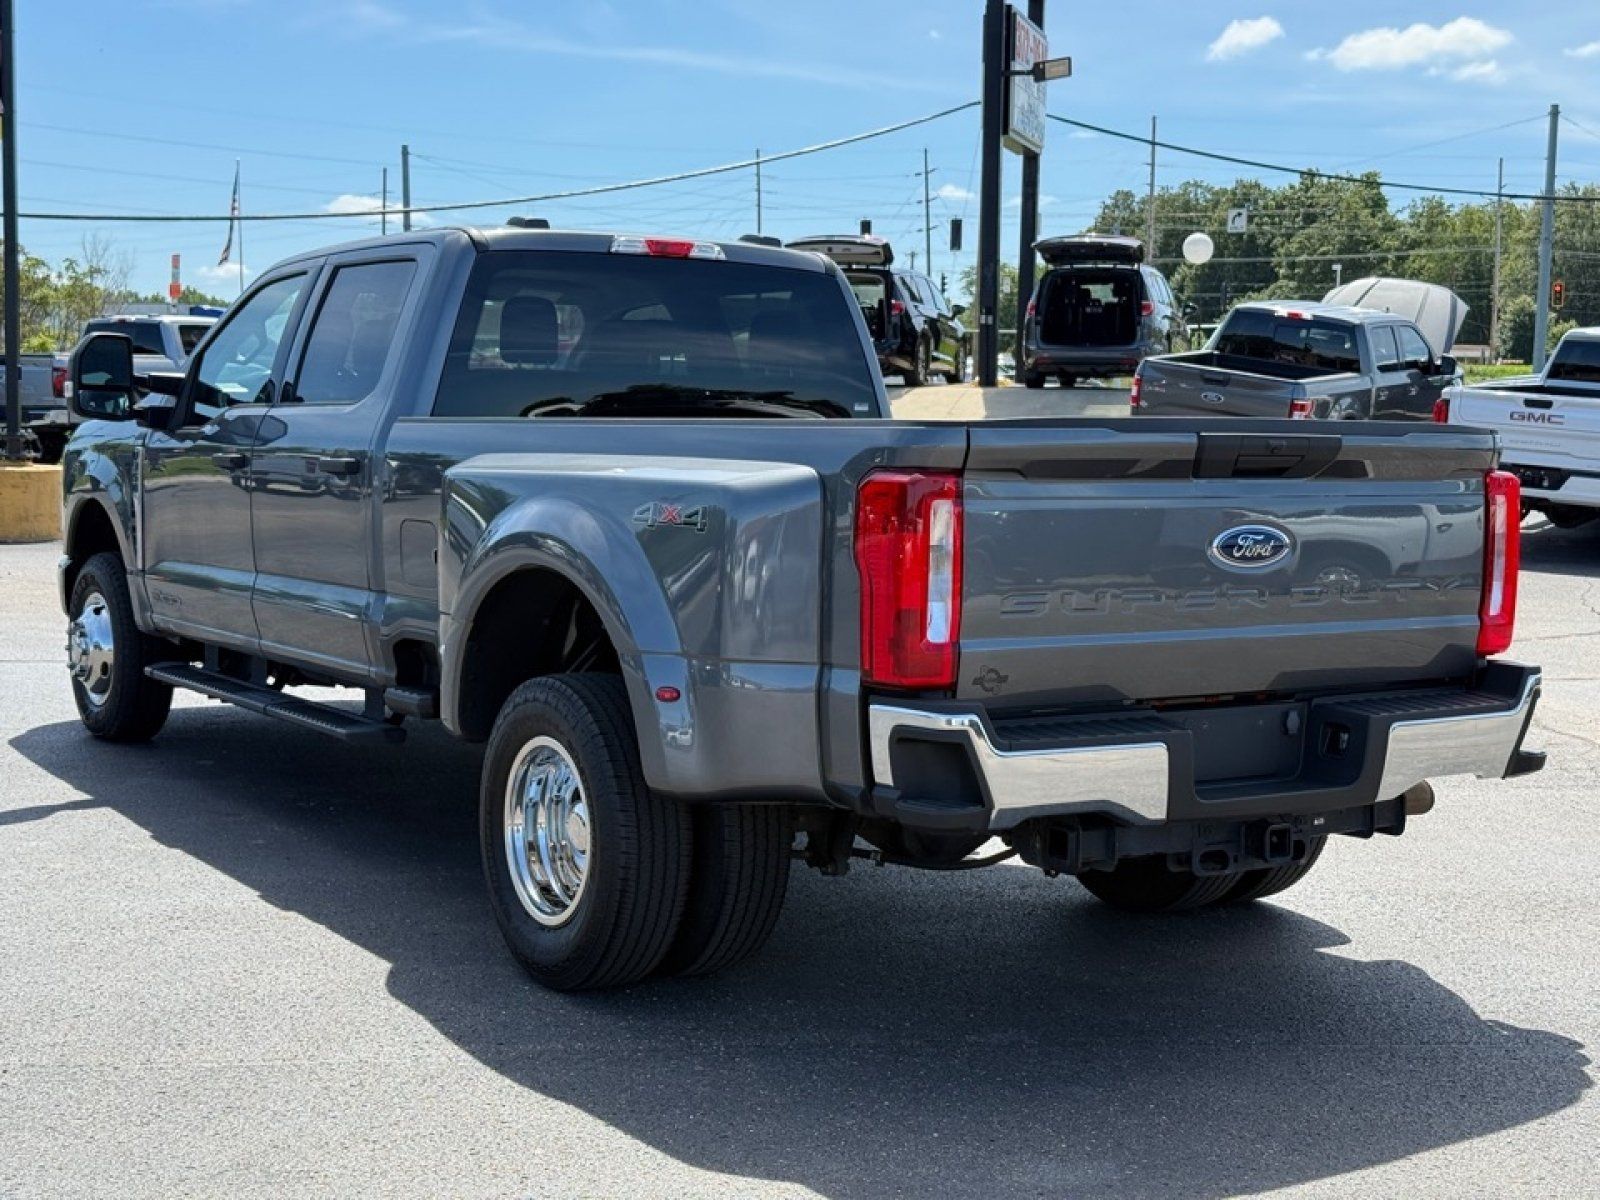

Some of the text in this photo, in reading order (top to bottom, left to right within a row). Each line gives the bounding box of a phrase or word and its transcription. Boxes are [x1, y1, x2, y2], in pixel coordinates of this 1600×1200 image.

[1509, 411, 1565, 425] GMC
[1232, 534, 1275, 557] Ford
[998, 587, 1268, 619] SUPER
